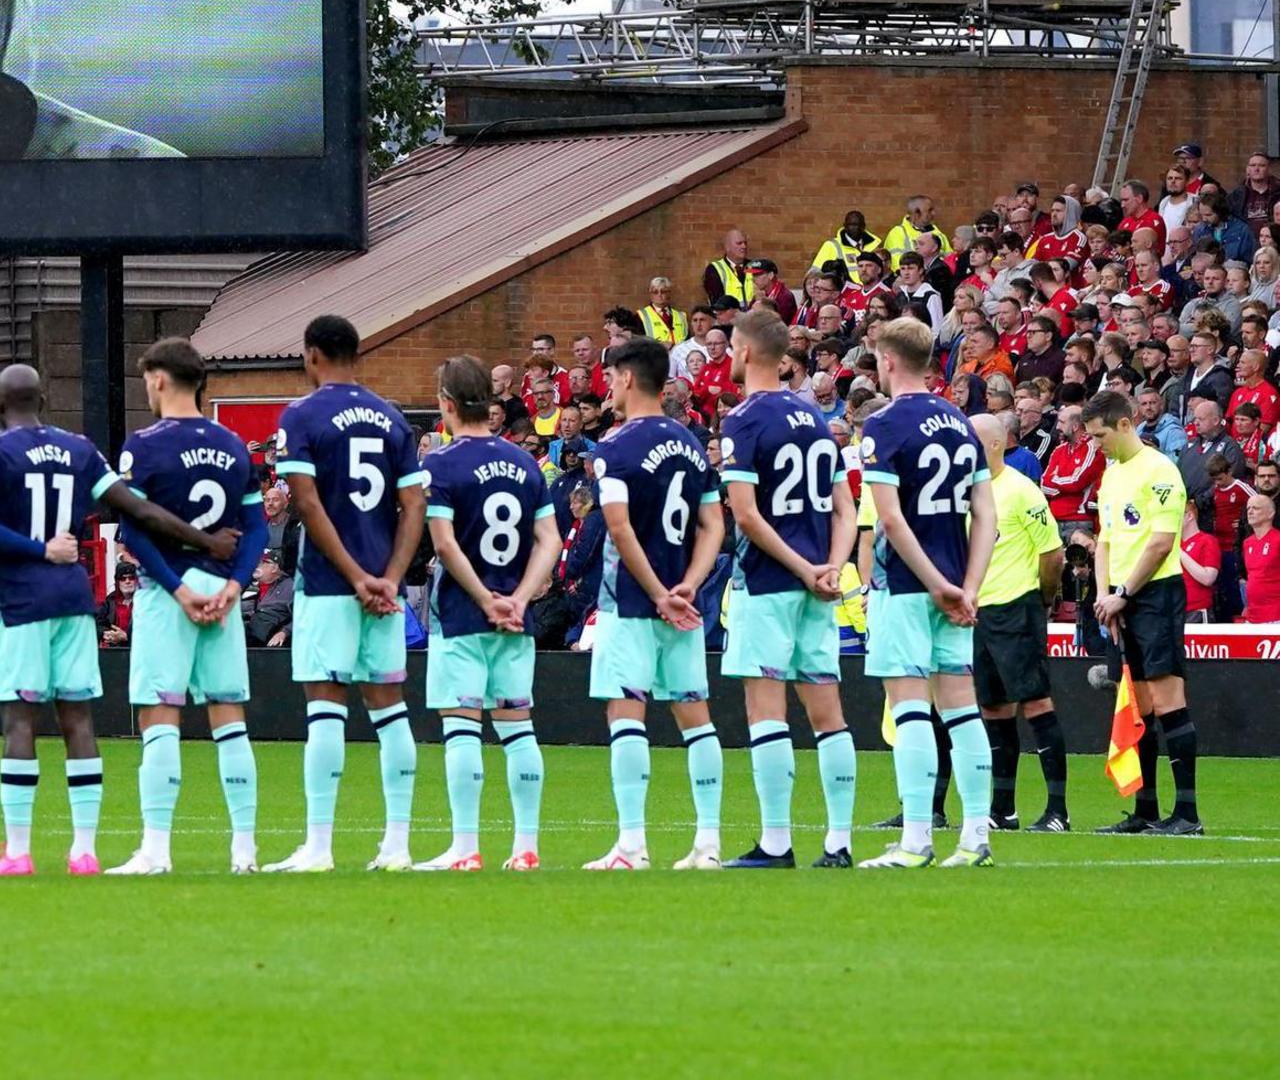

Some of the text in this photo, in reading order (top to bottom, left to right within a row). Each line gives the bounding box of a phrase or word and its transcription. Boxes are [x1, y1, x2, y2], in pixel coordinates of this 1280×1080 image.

[331, 407, 393, 433] PINNOCK
[785, 411, 816, 430] AJER
[918, 416, 970, 438] COLLINS
[26, 444, 72, 467] WISSA
[180, 448, 236, 471] HICKEY
[348, 437, 386, 512] 5
[473, 460, 528, 485] JENSEN
[640, 438, 708, 474] NØRGAARD
[771, 438, 838, 517] 20
[918, 443, 977, 516] 22
[25, 472, 75, 542] 11
[184, 479, 227, 551] 2
[479, 492, 523, 567] 8
[661, 470, 690, 546] 6
